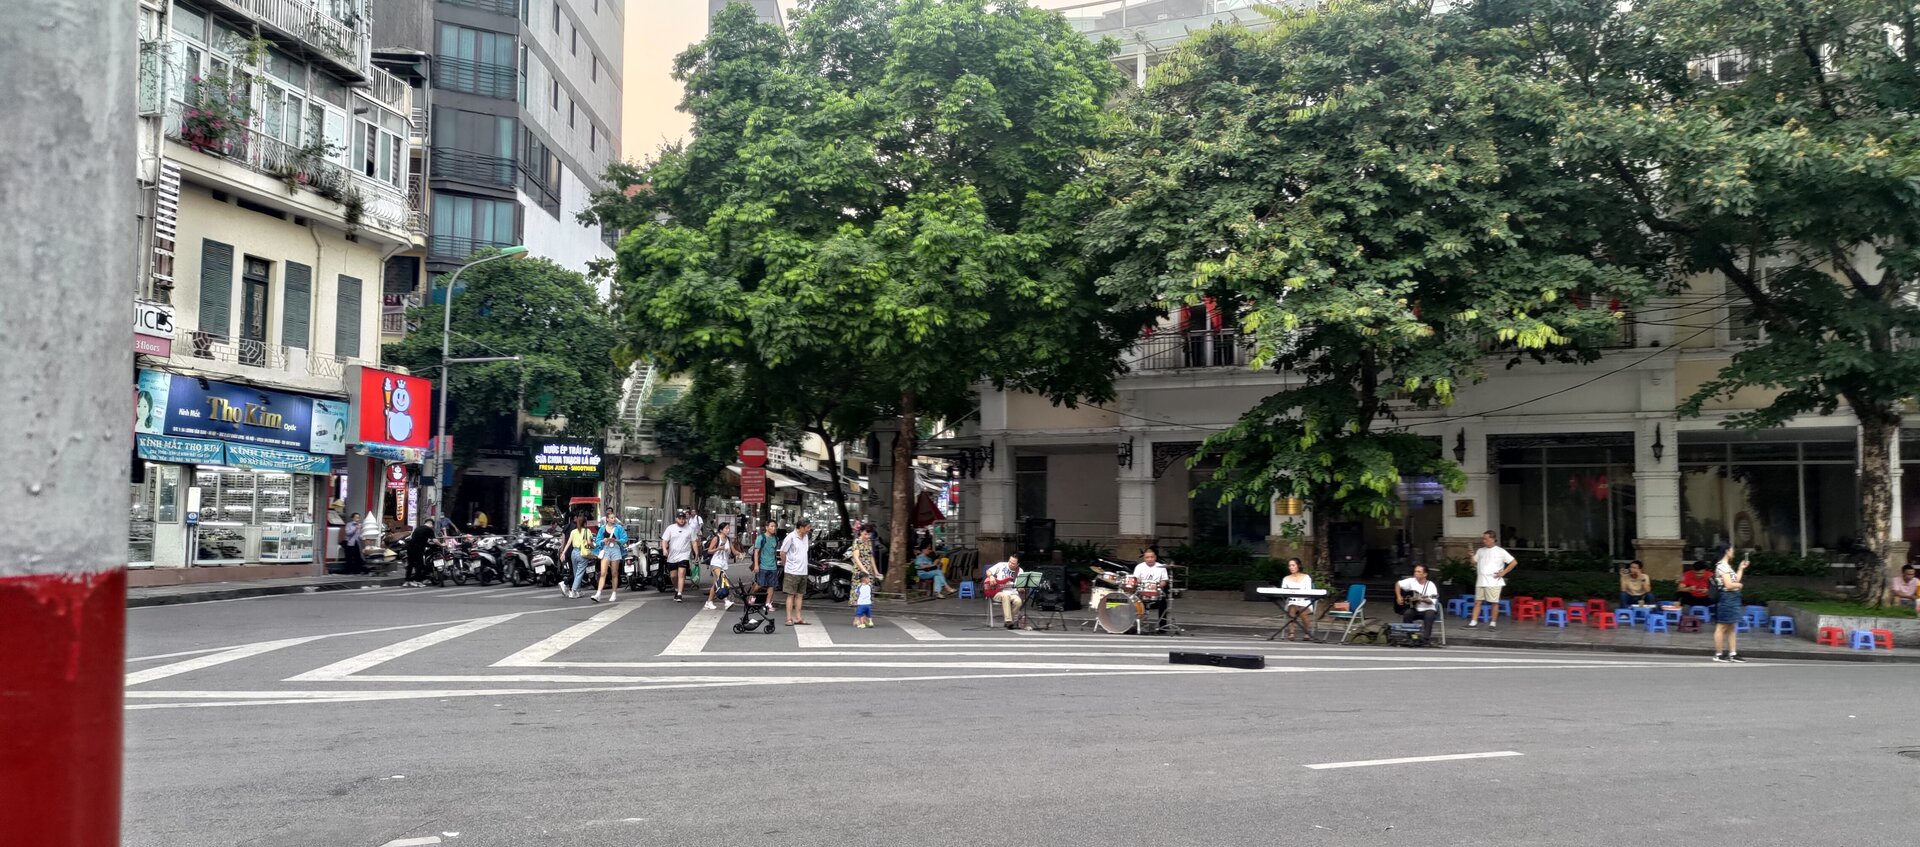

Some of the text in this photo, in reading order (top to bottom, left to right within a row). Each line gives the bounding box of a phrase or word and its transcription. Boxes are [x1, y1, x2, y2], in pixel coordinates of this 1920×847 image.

[206, 396, 243, 429] Thọ
[244, 402, 282, 428] Kim
[140, 436, 162, 448] KÍNH
[184, 442, 202, 453] THỌ
